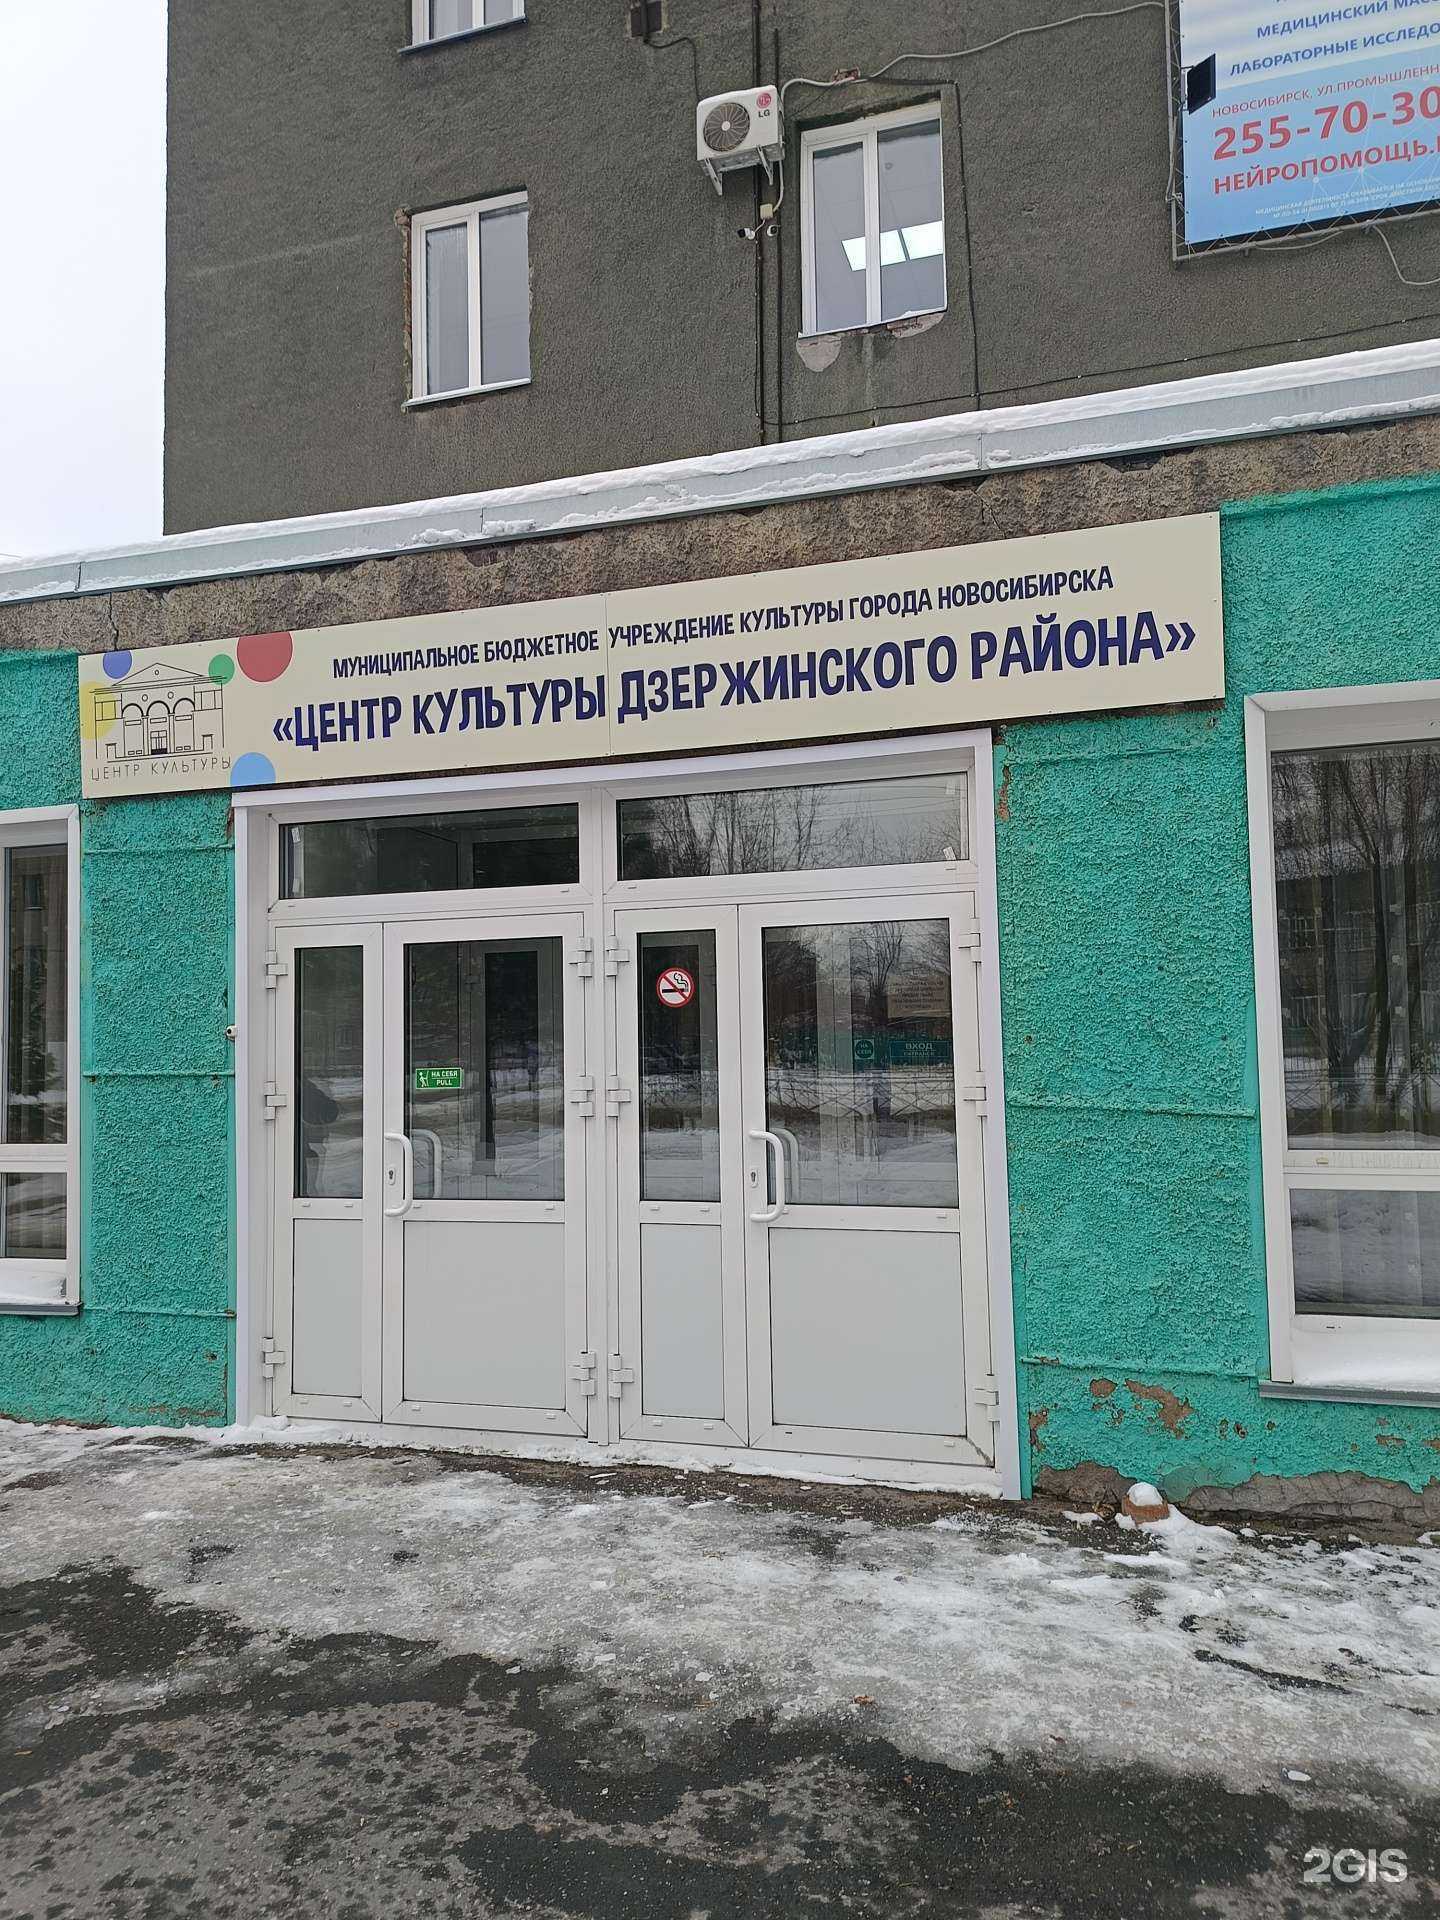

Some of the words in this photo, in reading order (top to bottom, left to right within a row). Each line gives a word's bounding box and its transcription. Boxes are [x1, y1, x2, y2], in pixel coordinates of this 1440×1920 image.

[1230, 38, 1358, 77] ЛАБОРАТОРНЫЕ
[1363, 22, 1440, 49] ИССЛЕДО
[758, 109, 771, 118] LG
[1212, 89, 1313, 119] НОВОСИБИРСК,
[1213, 86, 1440, 161] 255-70-30
[1214, 135, 1440, 195] НЕЙРОПОМОЩЬ.
[333, 643, 480, 679] МУНИЦИПАЛЬНОЕ
[484, 629, 600, 664] БЮДЖЕТНОЕ
[608, 613, 735, 649] УЧРЕЖДЕНИЕ
[739, 600, 844, 633] КУЛЬТУРЫ
[849, 588, 933, 620] ГОРОДА
[937, 566, 1114, 610] НОВОСИБИРСКА
[272, 695, 402, 752] «ЦЕНТР
[412, 675, 606, 735] КУЛЬТУРЫ
[617, 636, 958, 725] ДЗЕРЖИНСКОГО
[970, 611, 1196, 681] РАЙОНА»
[91, 763, 140, 781] ЦЕНТР
[151, 756, 231, 775] КУЛЬТУРЫ
